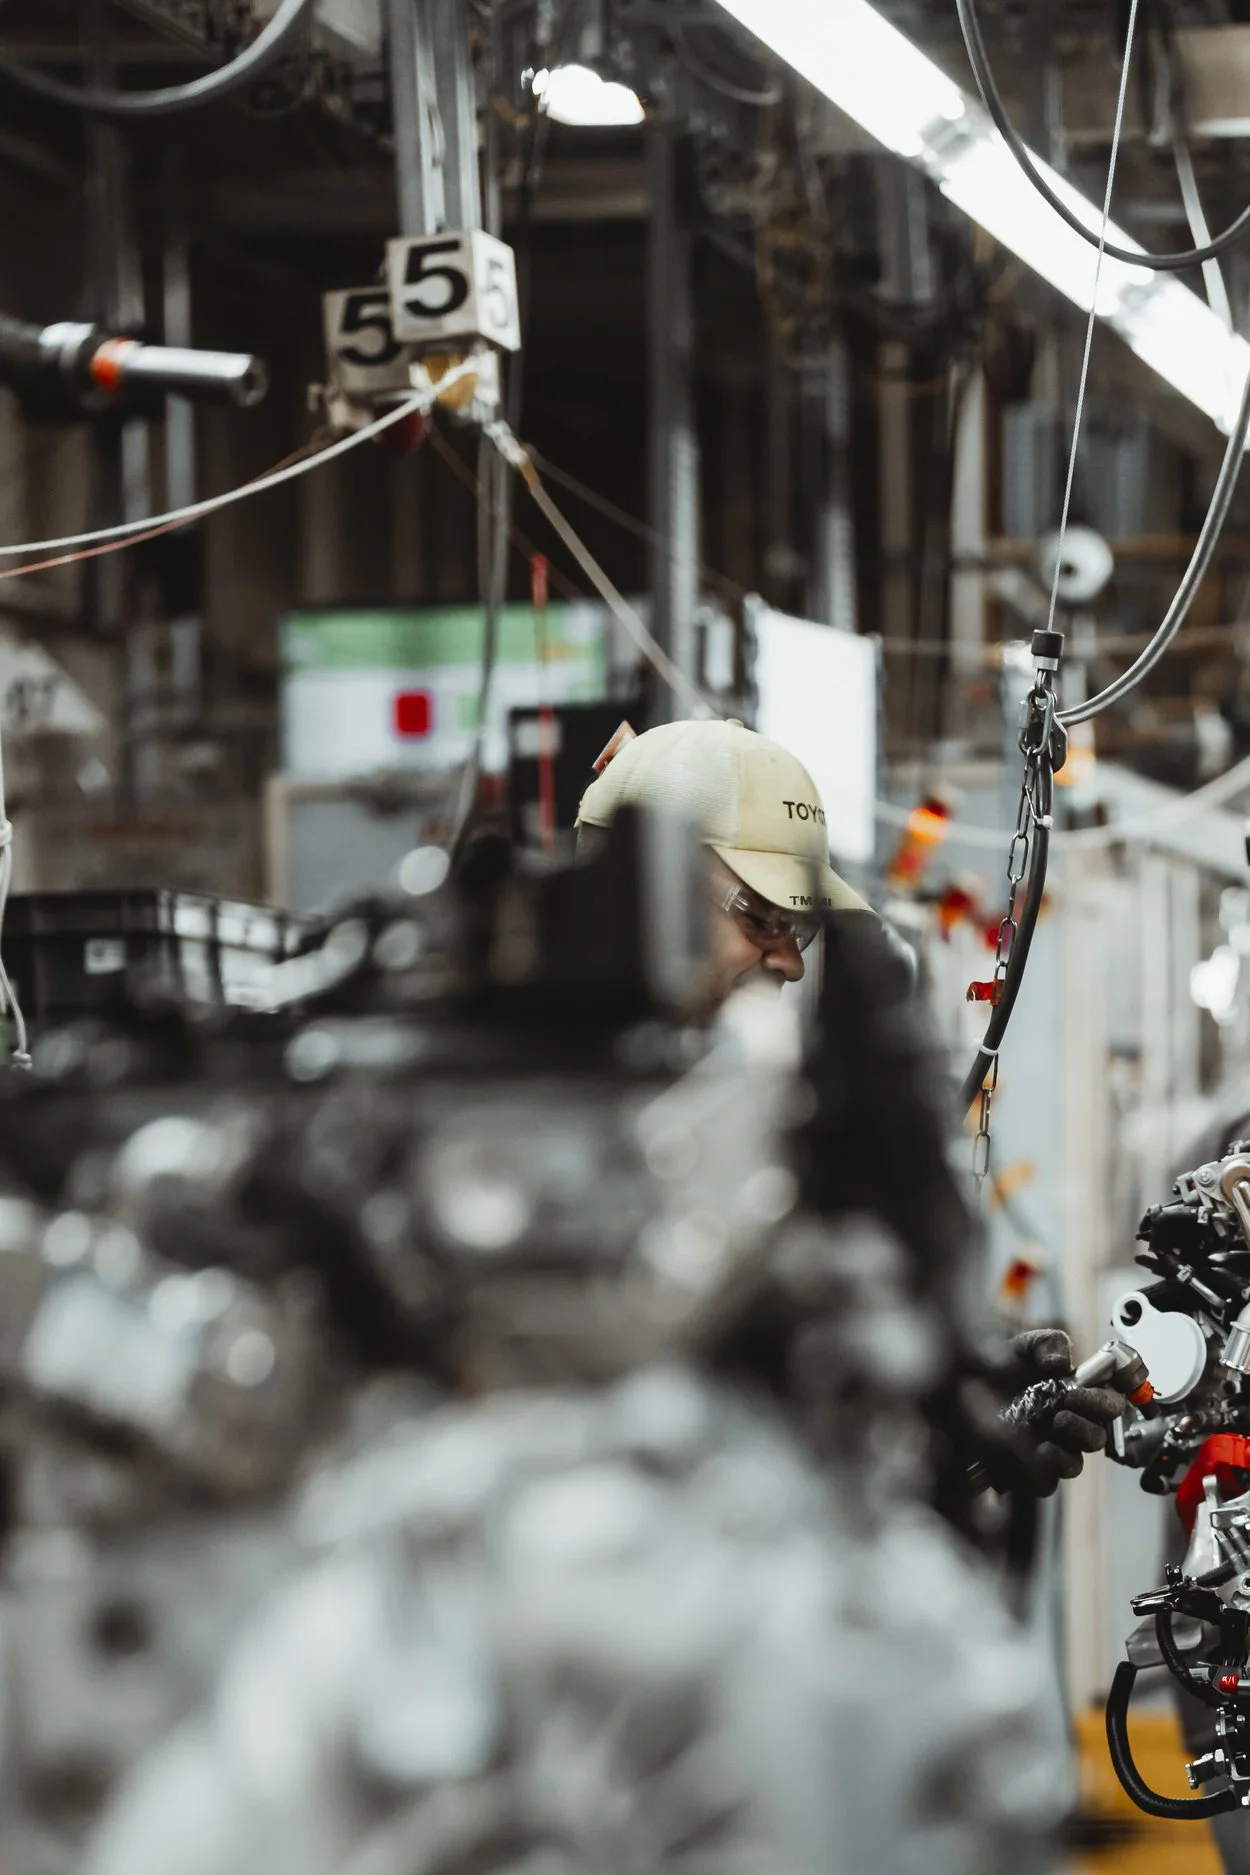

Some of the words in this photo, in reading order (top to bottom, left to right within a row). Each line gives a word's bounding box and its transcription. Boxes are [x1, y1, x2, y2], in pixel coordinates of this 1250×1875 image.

[403, 239, 470, 320] 5
[486, 257, 509, 329] 5
[339, 291, 402, 366] 5
[782, 800, 827, 826] TOYO
